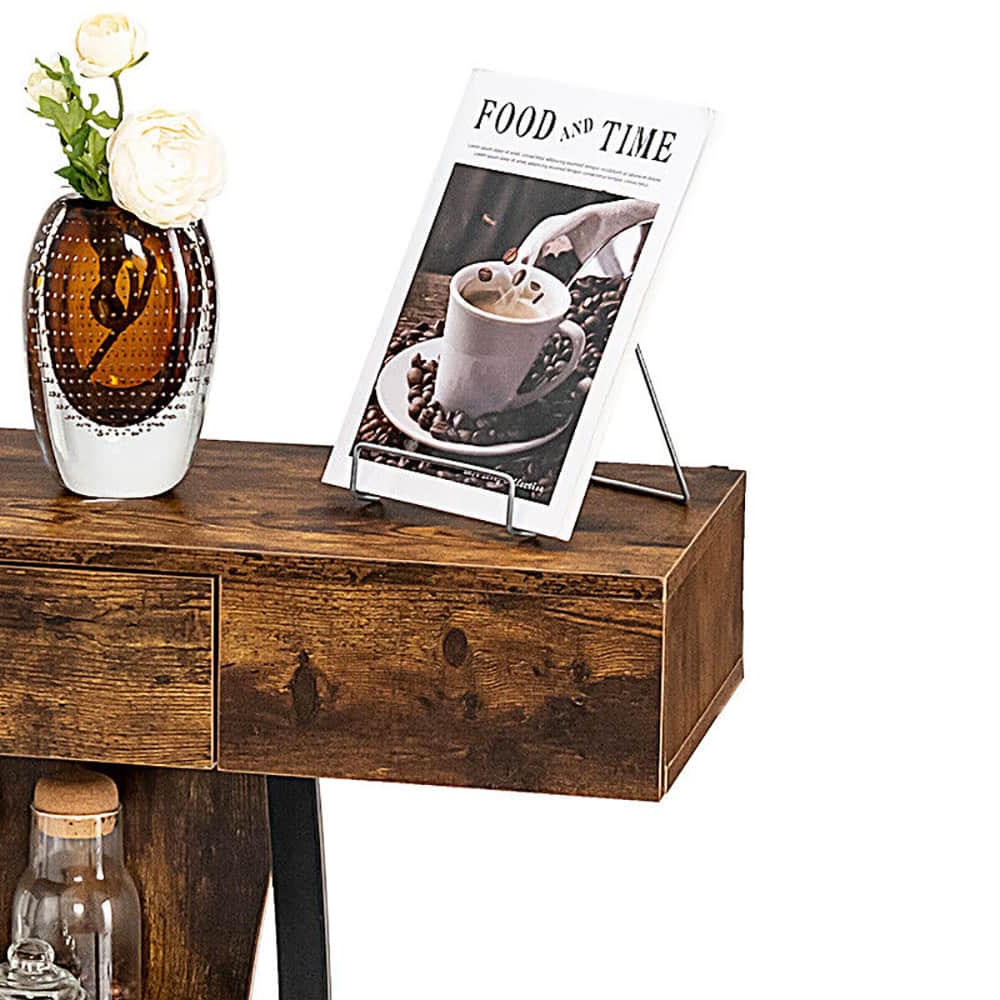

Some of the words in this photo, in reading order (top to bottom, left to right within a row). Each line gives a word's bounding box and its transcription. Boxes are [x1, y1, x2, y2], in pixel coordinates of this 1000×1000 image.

[474, 98, 557, 141] FOOD
[559, 116, 594, 142] AND
[599, 119, 677, 163] TIME
